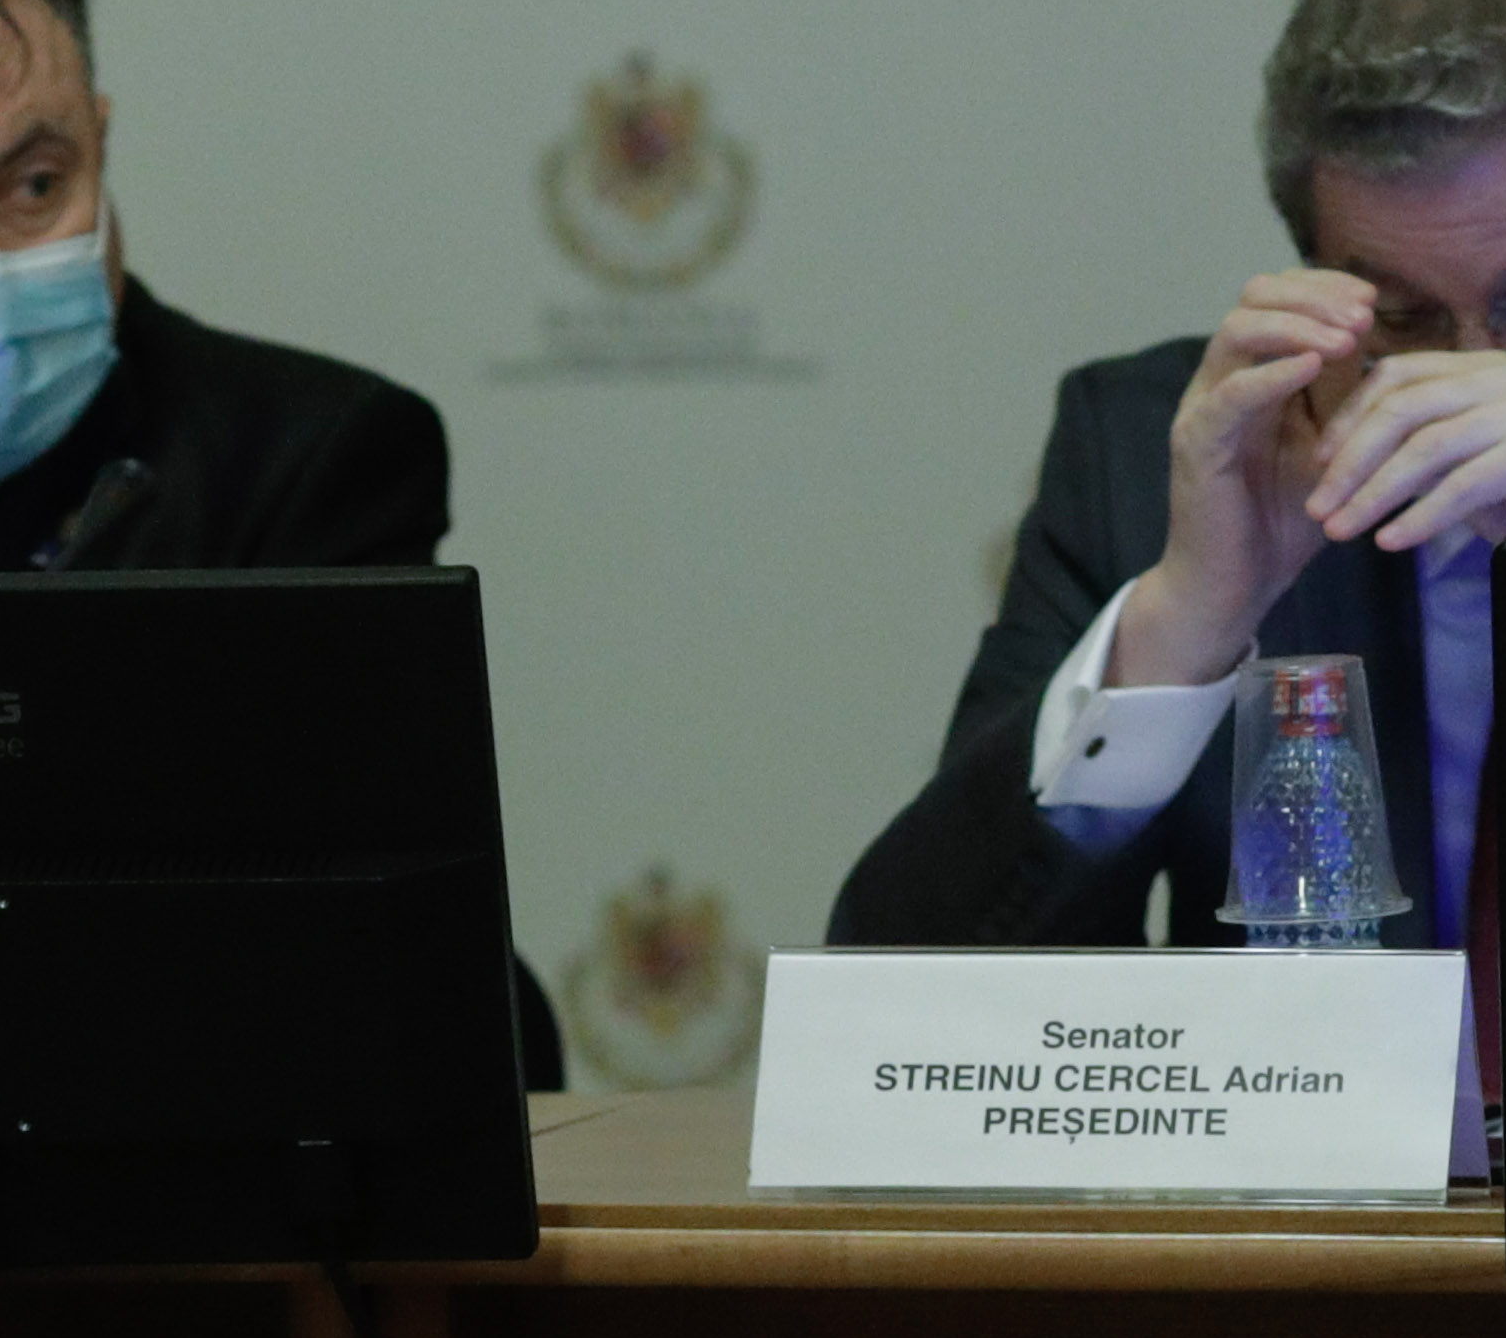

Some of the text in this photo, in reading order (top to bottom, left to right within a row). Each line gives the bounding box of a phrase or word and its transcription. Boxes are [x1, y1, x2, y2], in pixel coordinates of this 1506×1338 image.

[1041, 1020, 1185, 1050] Senator
[874, 1064, 1346, 1093] STREINU CERCEL Adrian
[983, 1107, 1228, 1144] PREȘEDINTE
